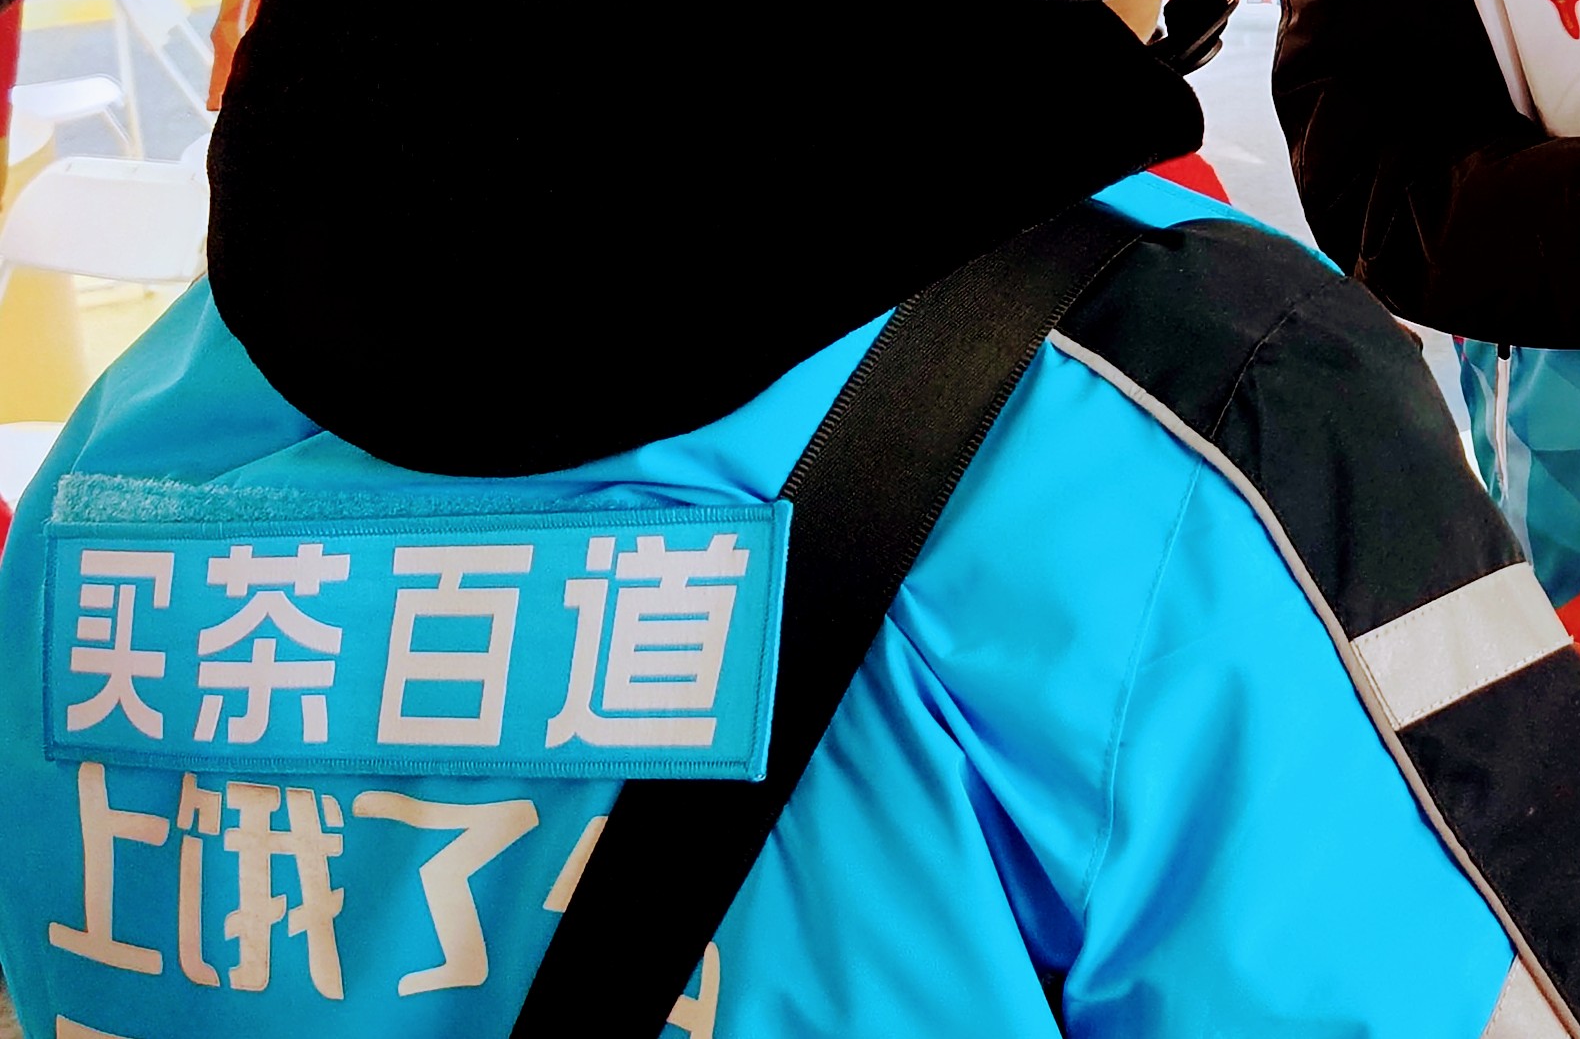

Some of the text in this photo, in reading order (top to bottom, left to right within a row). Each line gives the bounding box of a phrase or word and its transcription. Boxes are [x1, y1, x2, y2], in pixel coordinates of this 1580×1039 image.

[67, 533, 751, 749] 买茶百道
[48, 761, 610, 999] 上饿了
